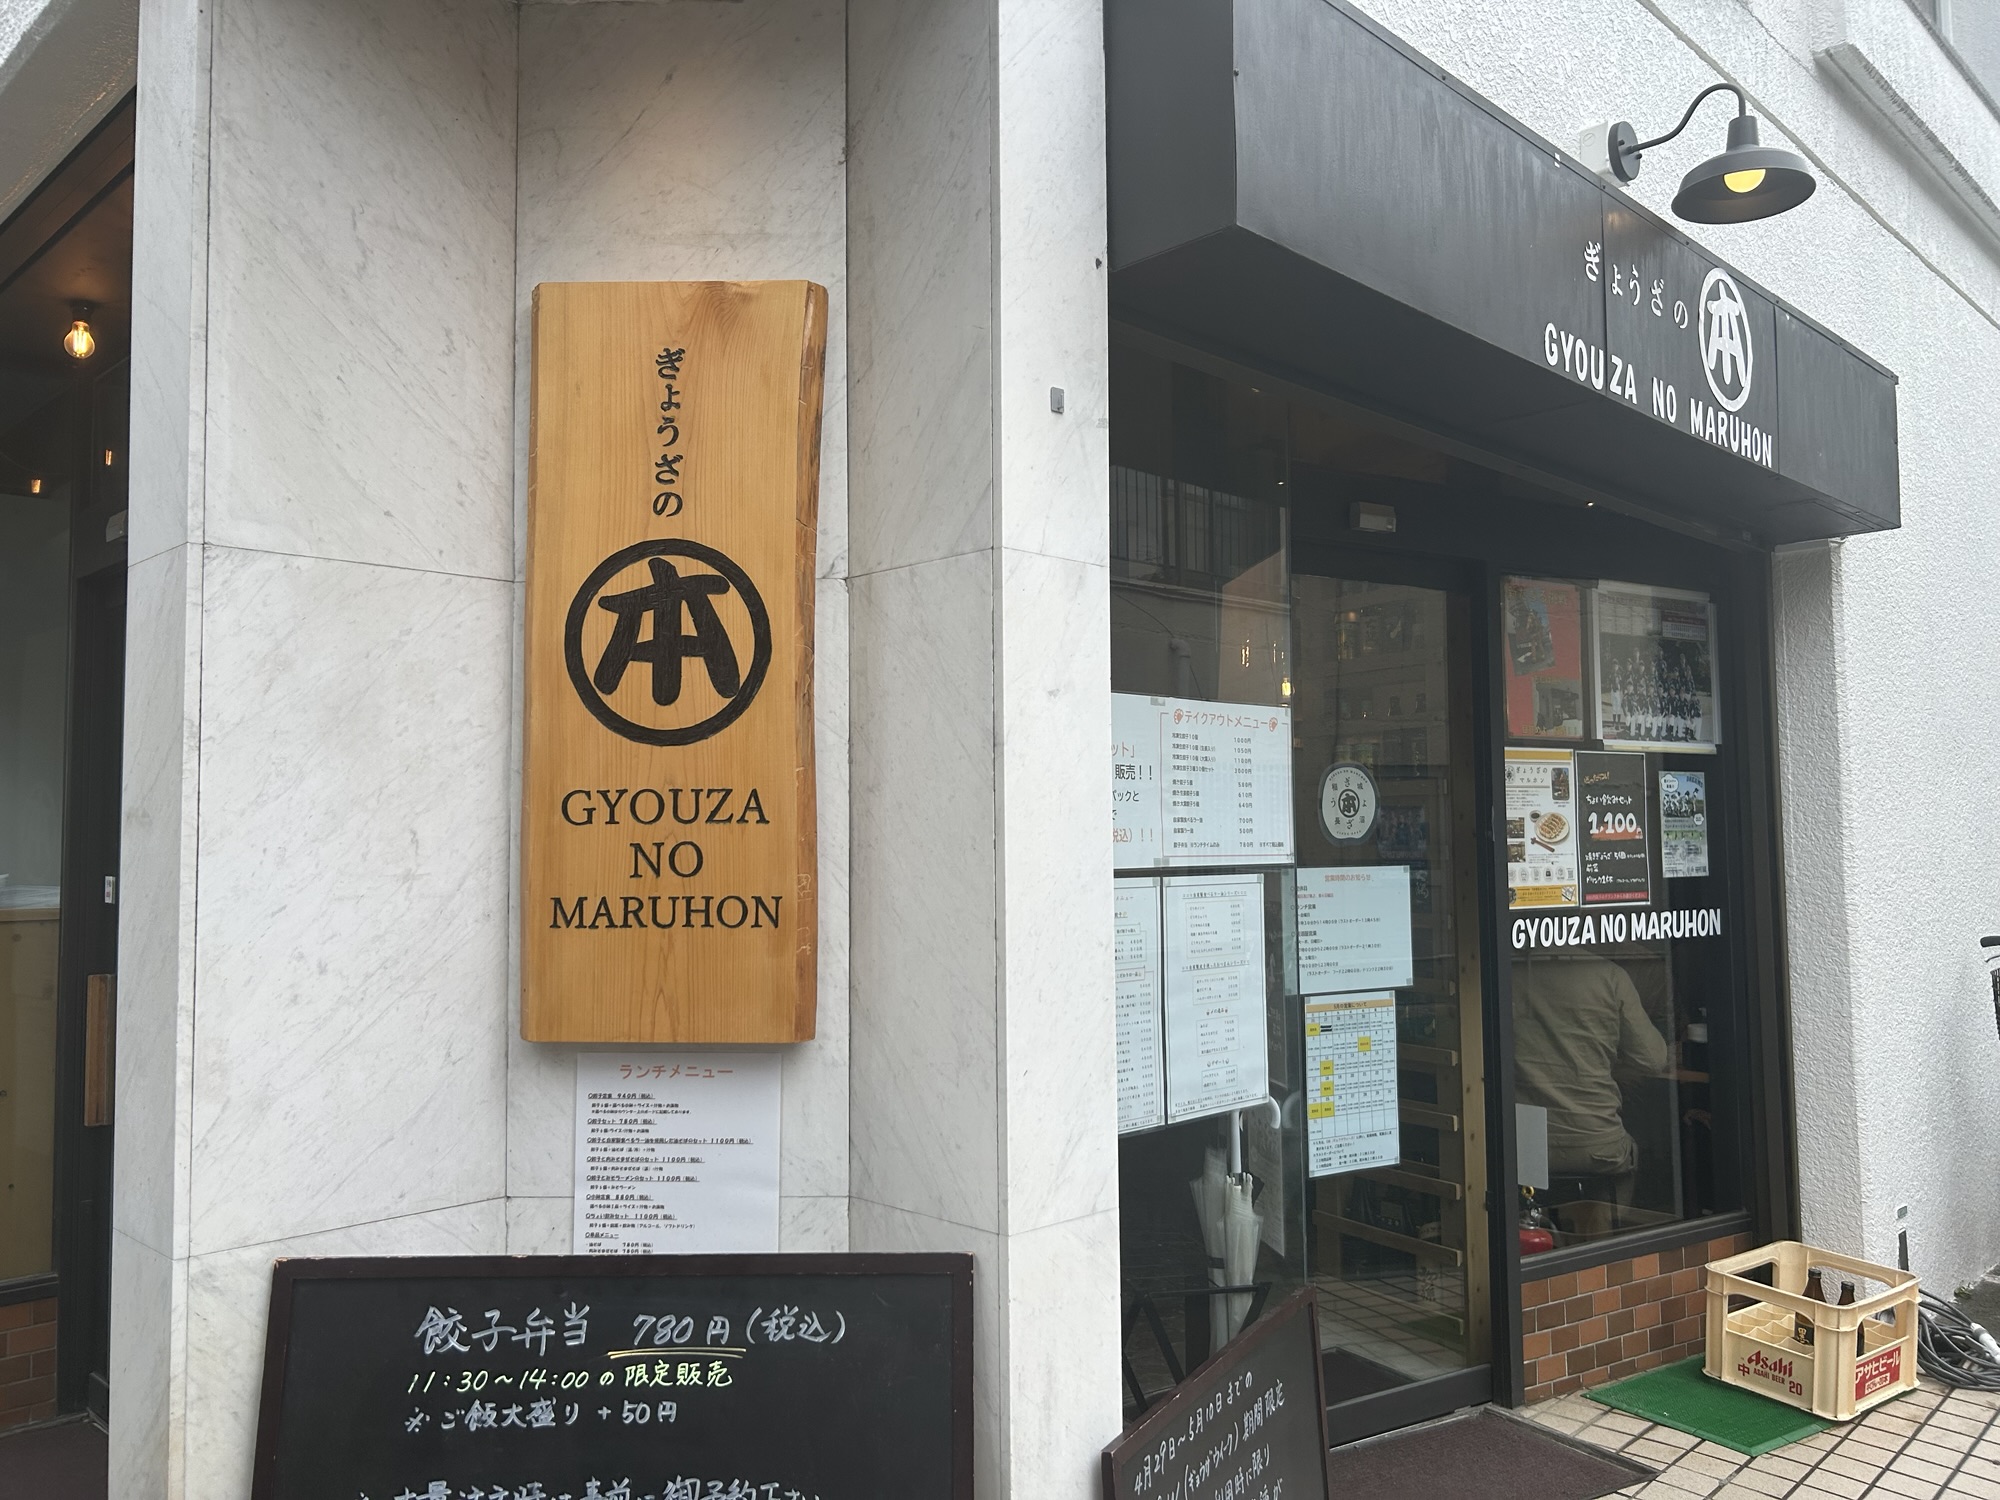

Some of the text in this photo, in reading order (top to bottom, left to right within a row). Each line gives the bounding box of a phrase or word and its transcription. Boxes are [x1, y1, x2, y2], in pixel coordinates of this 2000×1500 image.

[1583, 240, 1689, 329] ぎょうざの
[1543, 322, 1773, 469] GYOUZA NO MARUHON
[652, 347, 685, 517] ぎょうざの
[1185, 710, 1268, 729] テイクアウトメニュー
[560, 788, 771, 827] GYOUZA
[1585, 793, 1633, 806] ちょい飲みセット
[628, 841, 704, 878] NO
[550, 895, 784, 930] MARUHON
[1511, 908, 1721, 949] GYOUZA NO MARUHON
[619, 1064, 733, 1080] ランチメニュー
[414, 1301, 848, 1356] 餃子弁当 780円 (税込)
[1737, 1363, 1803, 1396] 中 ASAHI BEER 20
[1747, 1349, 1793, 1378] Asahi
[1855, 1350, 1900, 1384] アサヒビール
